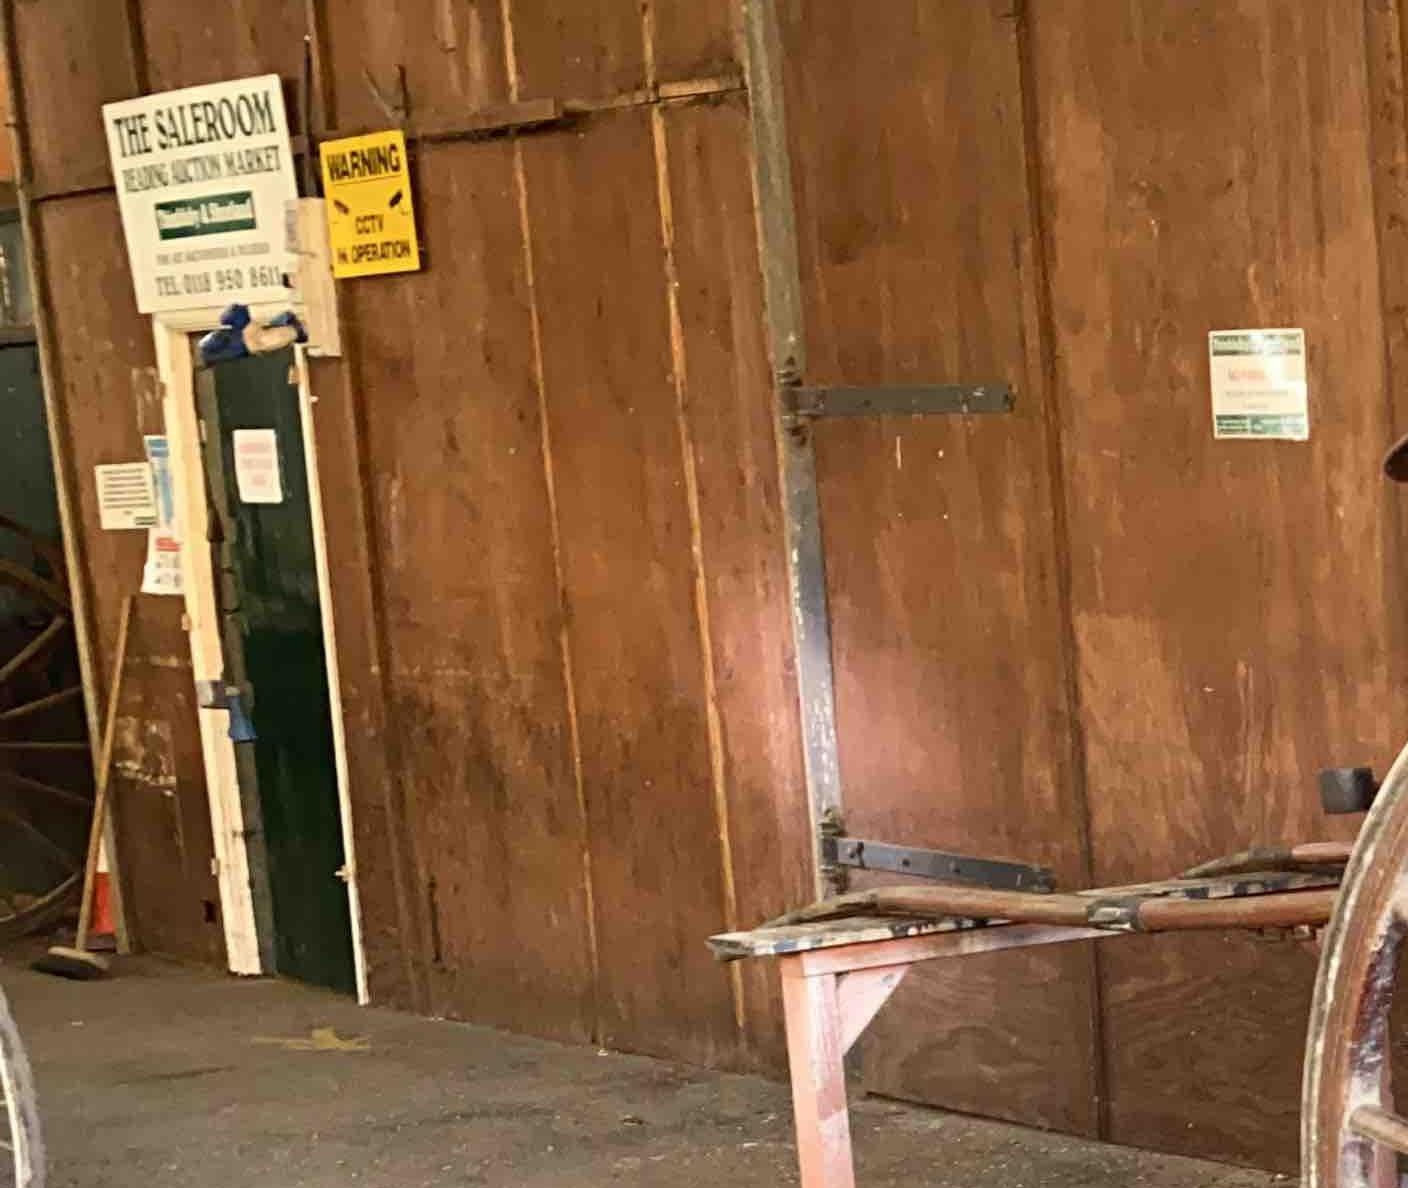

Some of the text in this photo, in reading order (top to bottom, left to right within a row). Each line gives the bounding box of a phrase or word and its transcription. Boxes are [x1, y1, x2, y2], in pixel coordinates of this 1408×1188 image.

[113, 90, 276, 158] THE SALEROOM
[122, 145, 281, 192] READING AUCTION MARKET
[326, 143, 401, 182] WARNING
[355, 213, 384, 235] CCTV
[337, 239, 411, 264] IN OPERATION
[216, 268, 243, 291] 950
